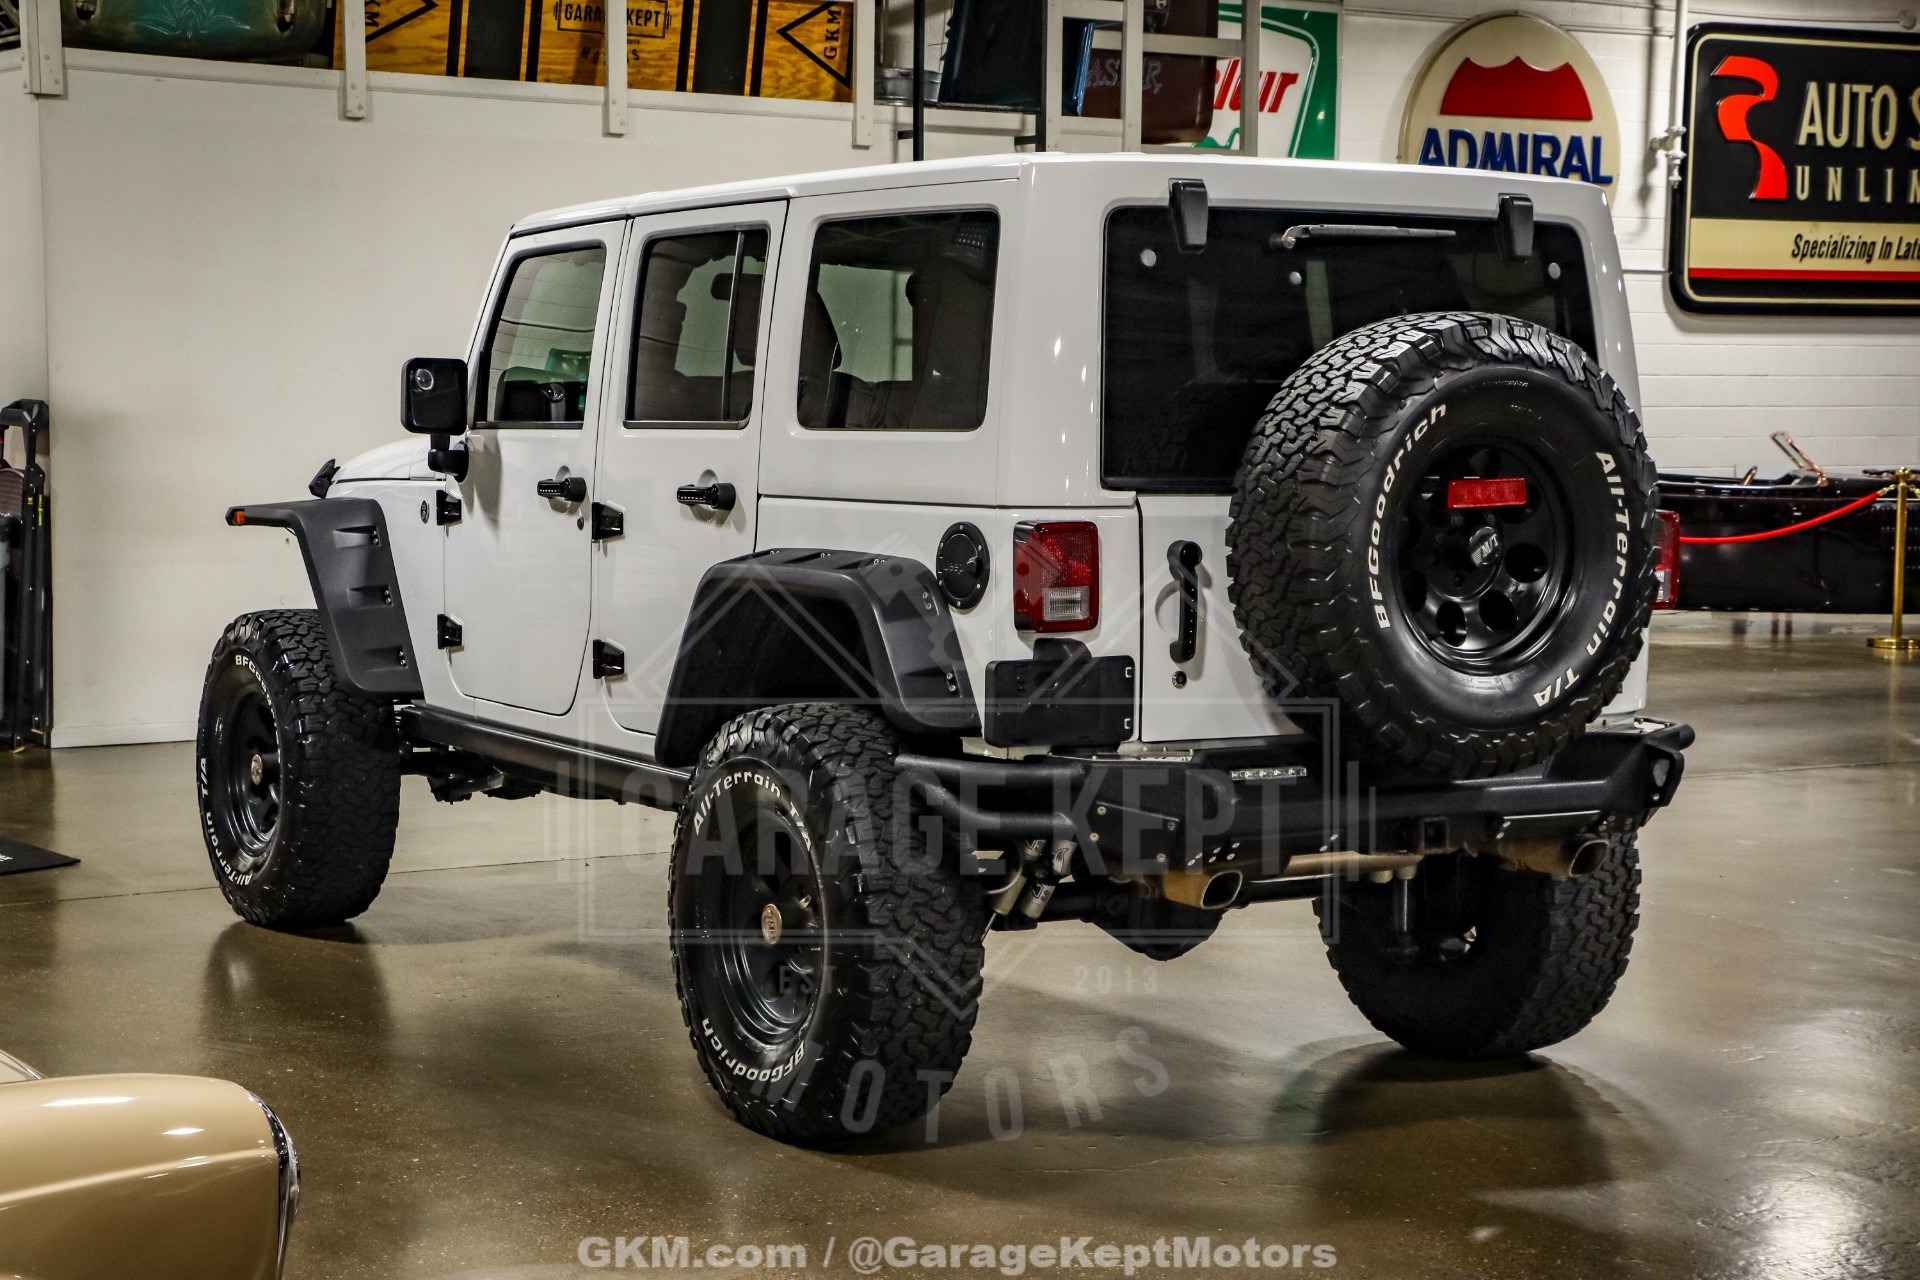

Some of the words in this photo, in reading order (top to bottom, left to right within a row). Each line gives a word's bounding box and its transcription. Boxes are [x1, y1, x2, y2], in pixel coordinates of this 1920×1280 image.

[626, 8, 661, 28] KEPT
[823, 8, 842, 60] GKM
[1797, 81, 1898, 150] AUTO
[1418, 127, 1613, 184] ADMIRAL
[1791, 233, 1877, 264] Specializing
[1878, 235, 1893, 258] In
[1368, 404, 1447, 629] BFGoodrich
[1585, 451, 1631, 656] All-Terrain
[1532, 667, 1579, 707] T/A
[200, 758, 208, 798] T/A
[694, 771, 781, 836] All-Terrain
[789, 801, 812, 852] T/A
[206, 812, 253, 885] All-Terrain
[702, 1018, 804, 1083] BFGoodrich
